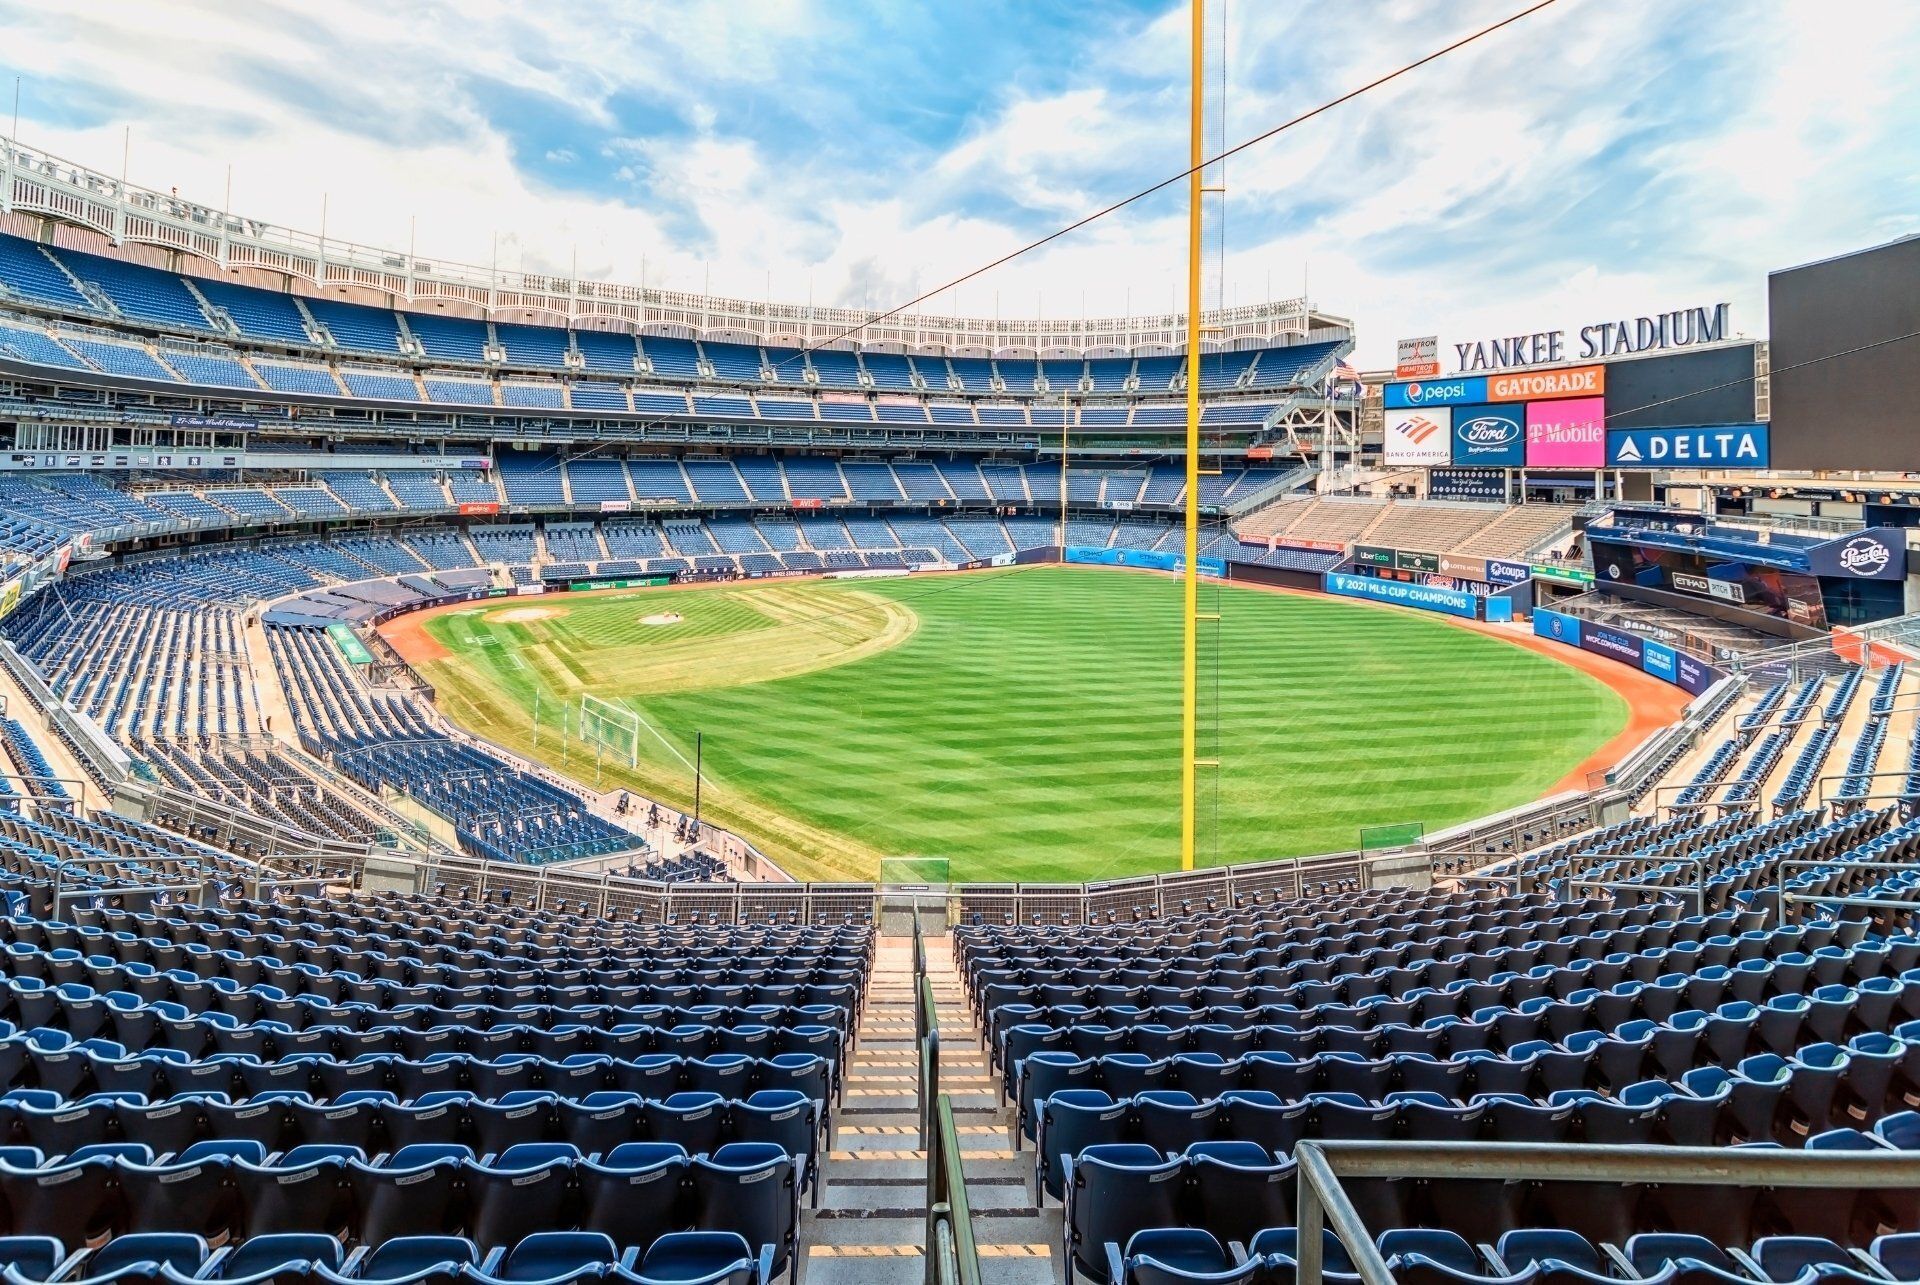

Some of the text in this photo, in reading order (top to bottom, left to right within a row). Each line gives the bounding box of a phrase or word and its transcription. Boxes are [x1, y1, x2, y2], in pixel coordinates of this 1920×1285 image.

[1399, 340, 1436, 350] ARMITRON
[1454, 303, 1731, 371] YANKEE STADIUM
[1401, 364, 1434, 372] ARMITRON
[1425, 382, 1465, 401] pepsi
[1494, 371, 1597, 396] GATORADE
[1468, 421, 1508, 441] Ford
[1547, 422, 1603, 443] Mobile
[1650, 433, 1758, 459] DELTA
[1360, 552, 1375, 560] Uber
[1466, 565, 1485, 573] HOTELS
[1501, 567, 1526, 579] coupa
[1675, 577, 1728, 594] ETIHAD PITCH
[1347, 581, 1467, 609] 2021 MLS CUP CHAMPIONS
[1597, 631, 1629, 646] JOIN THE CLUB
[1646, 649, 1657, 658] CITY
[1661, 654, 1671, 664] THE
[1646, 656, 1672, 671] COMMUNITY
